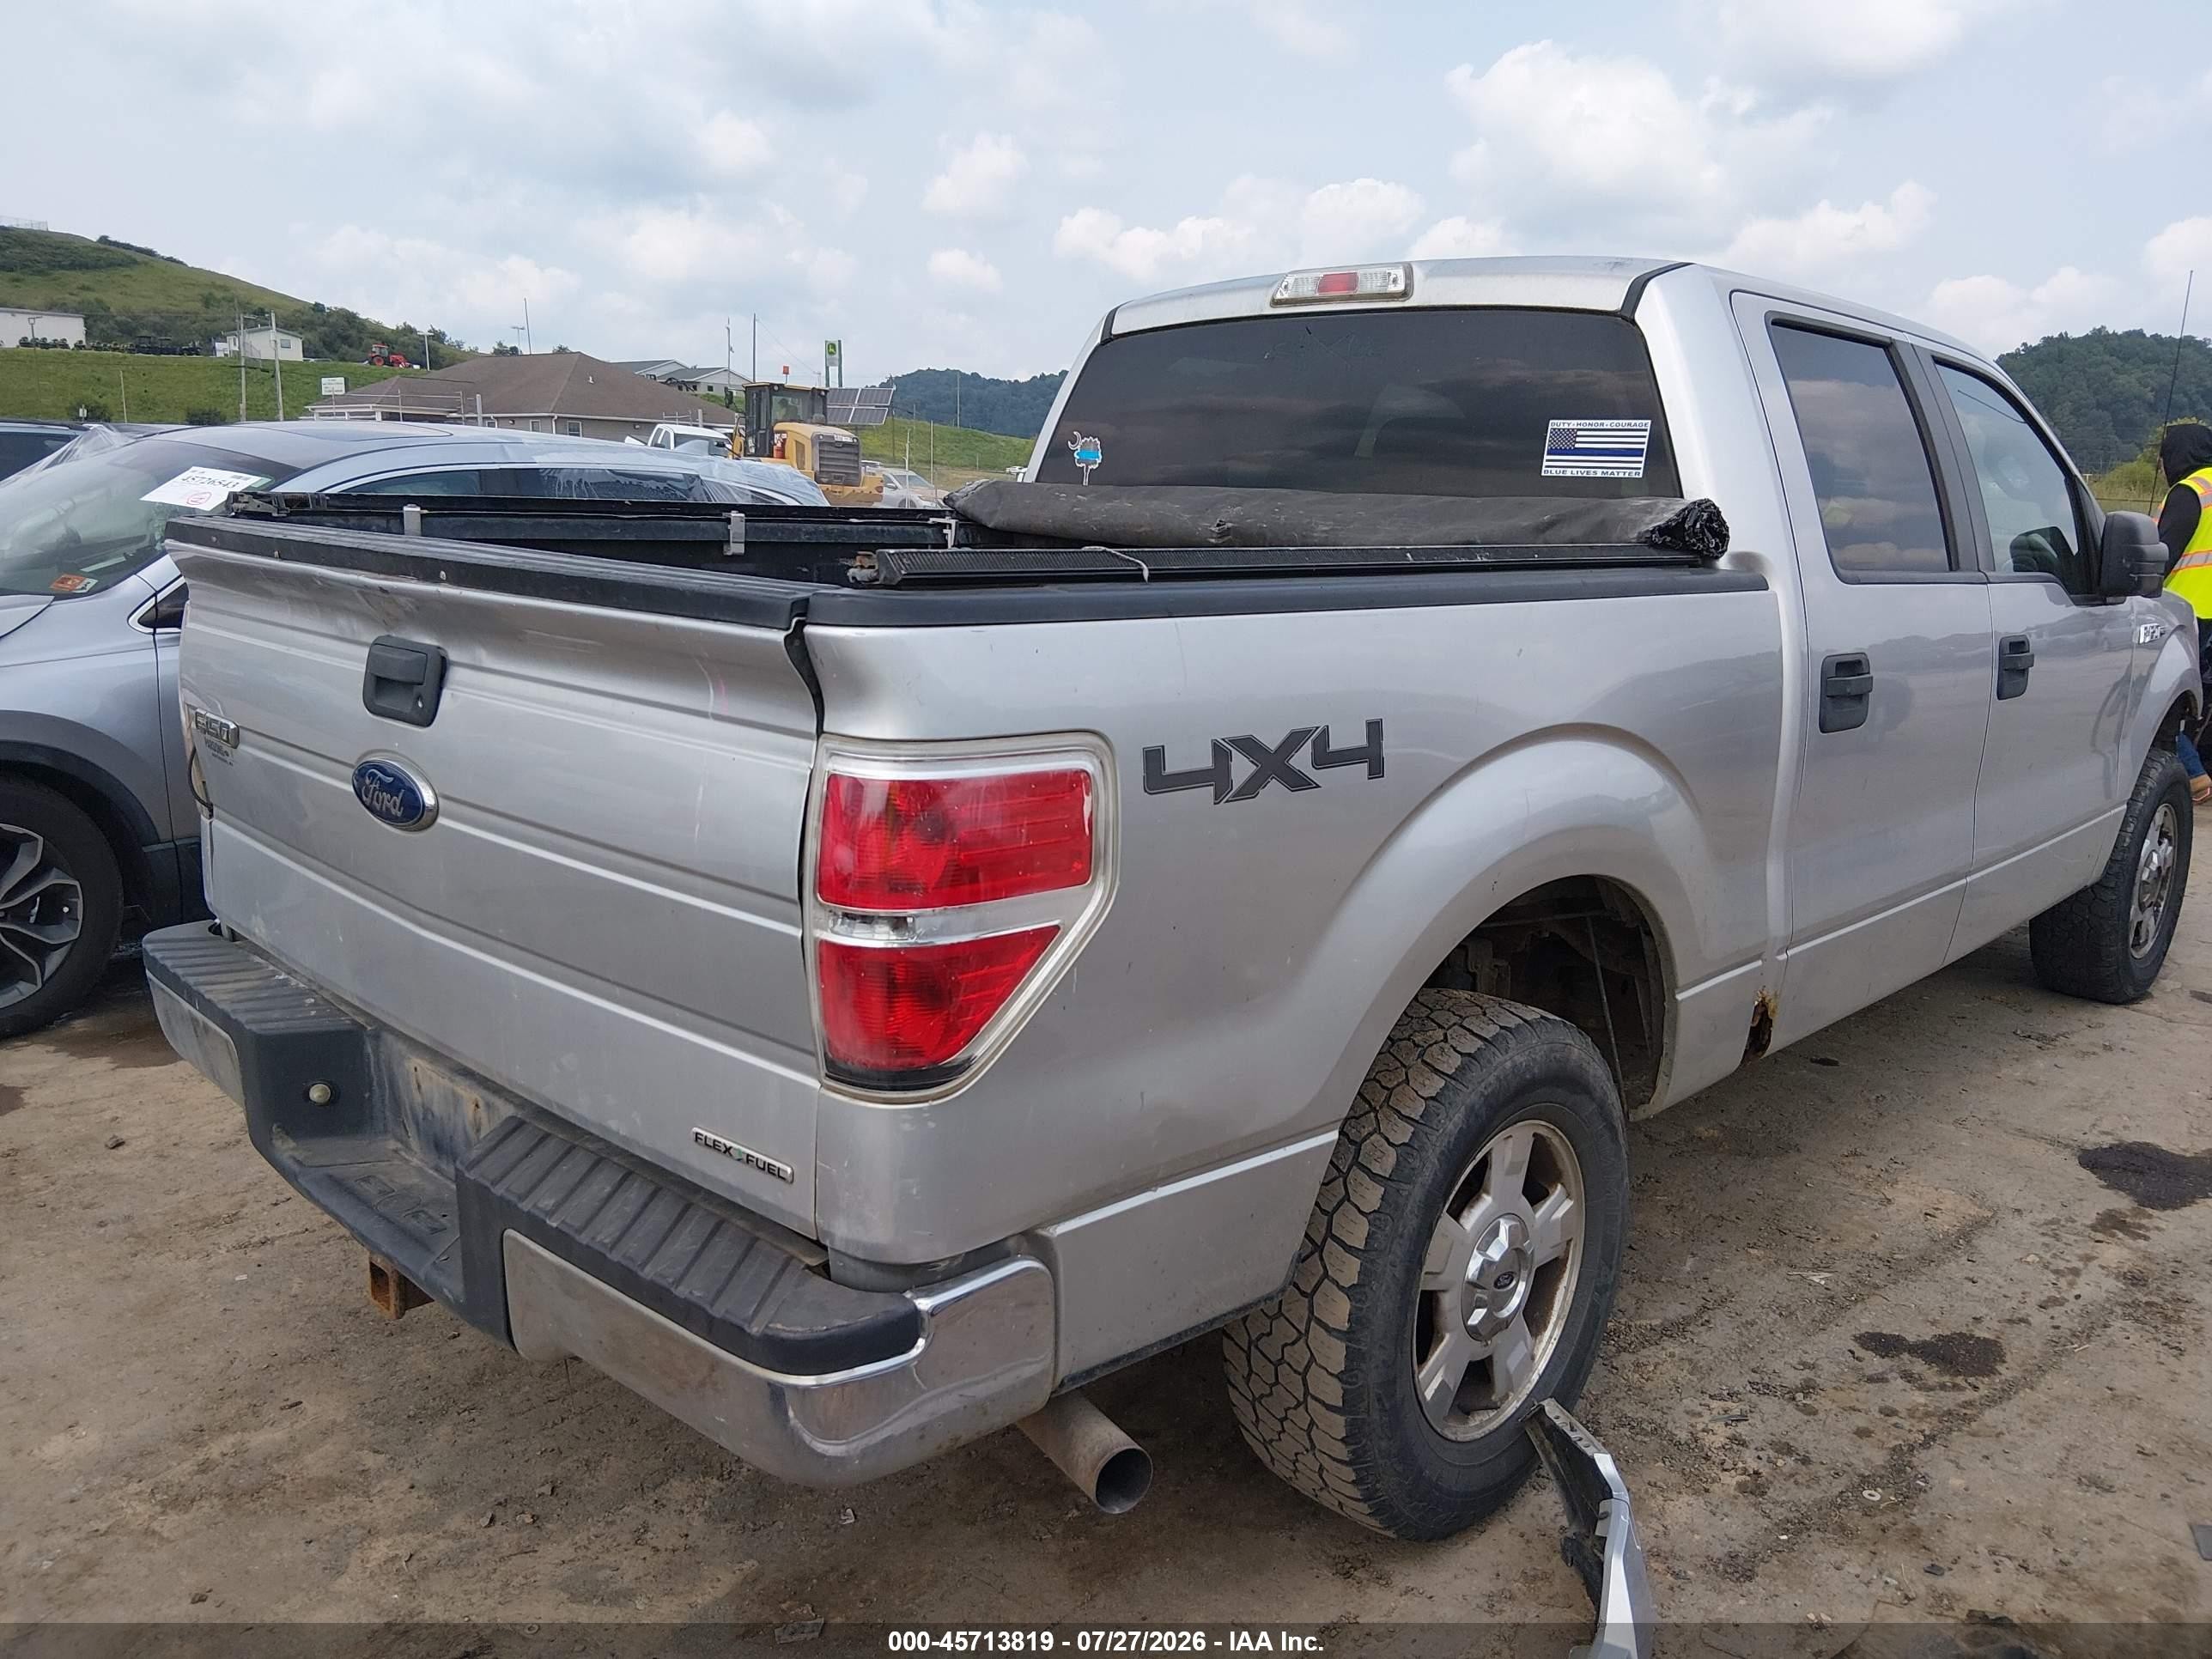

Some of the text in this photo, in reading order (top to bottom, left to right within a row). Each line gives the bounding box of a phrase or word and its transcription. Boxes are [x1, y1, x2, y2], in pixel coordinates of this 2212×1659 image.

[1142, 718, 1385, 805] 4X4
[362, 769, 405, 817] Ford
[695, 1132, 787, 1182] FLEX FUEL
